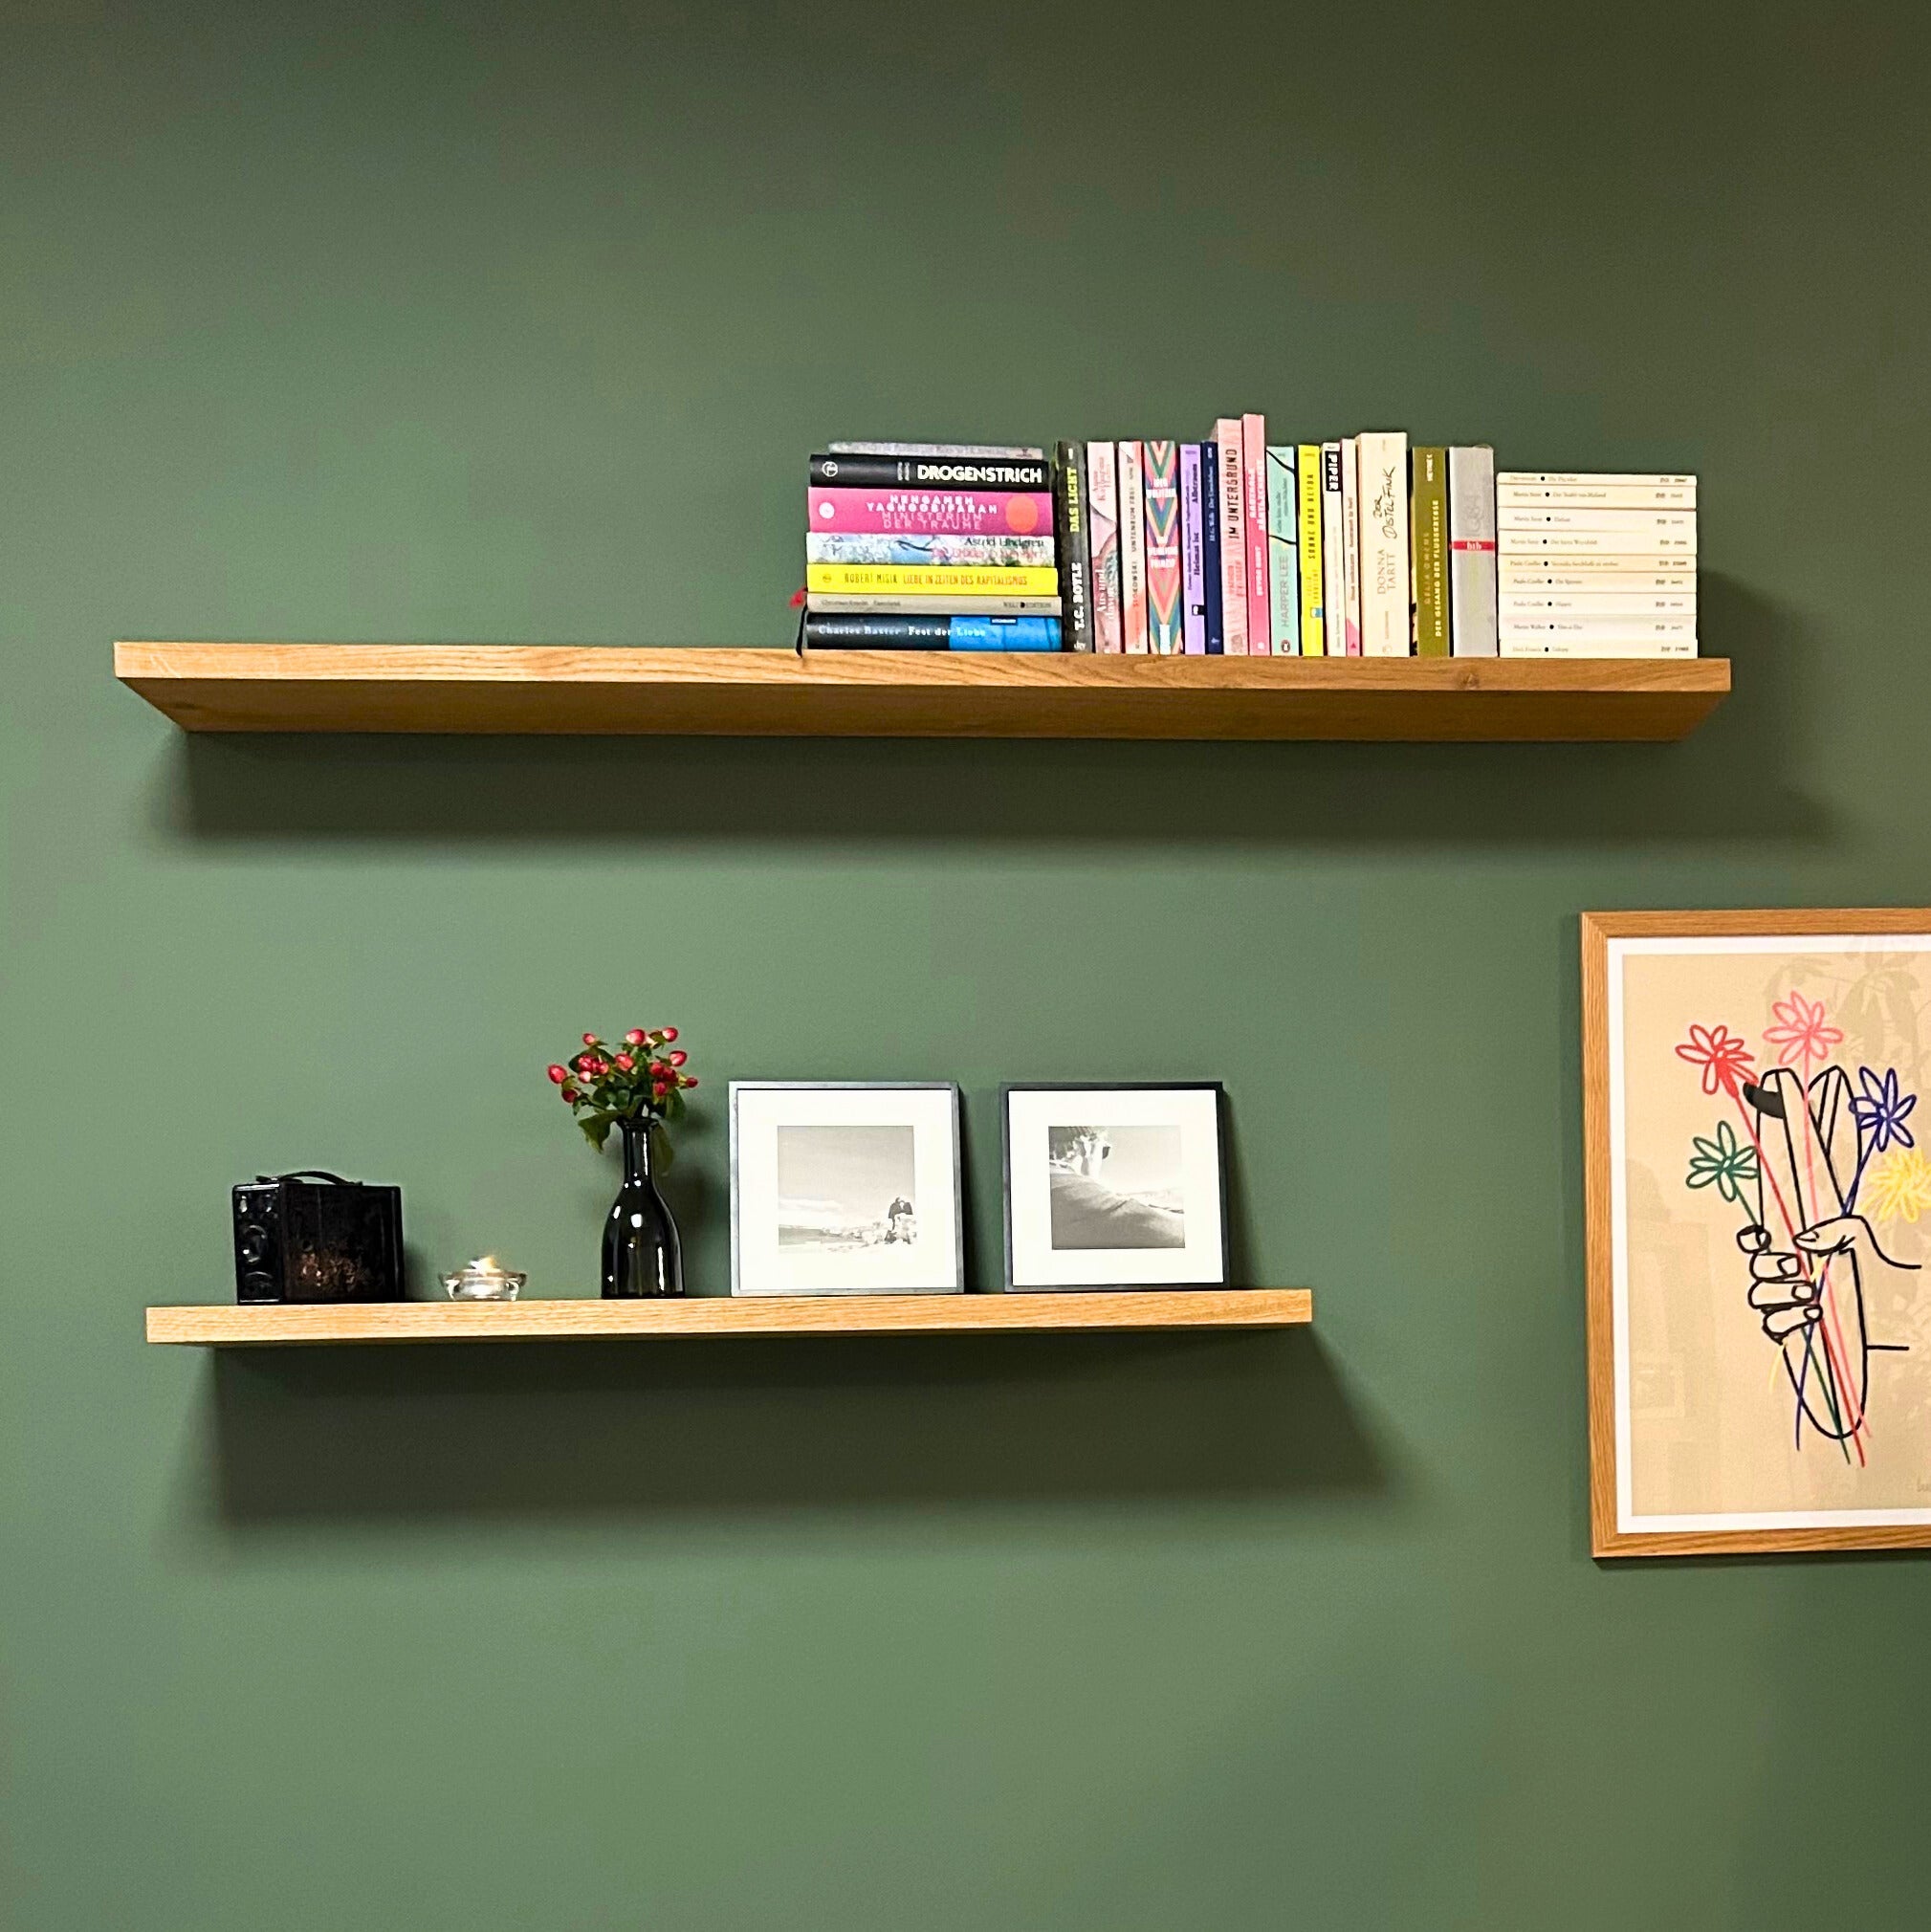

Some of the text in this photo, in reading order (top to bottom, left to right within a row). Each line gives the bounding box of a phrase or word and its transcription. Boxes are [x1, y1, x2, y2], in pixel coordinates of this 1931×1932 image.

[917, 464, 1042, 483] DROGENSTRICH
[1066, 467, 1078, 505] LICHT
[1328, 454, 1338, 491] PIPER
[1225, 449, 1240, 539] IM UNTERGRUND
[882, 512, 982, 521] MINISTERIUM
[883, 519, 912, 529] DER
[1069, 507, 1080, 533] DAS
[964, 537, 1044, 549] Astrid Lindgren
[845, 573, 873, 583] ROBERT
[903, 574, 923, 585] LIEBE
[925, 575, 933, 584] IN
[934, 575, 958, 585] ZEITEN
[960, 575, 974, 585] DES
[976, 575, 1028, 585] KAPITALISMUS
[1071, 562, 1083, 604] BOYLE
[1376, 548, 1386, 595] DONNA
[1386, 553, 1396, 590] TARTT
[1279, 555, 1289, 627] HARPER LEE
[818, 624, 863, 635] Charles
[934, 626, 952, 636] der
